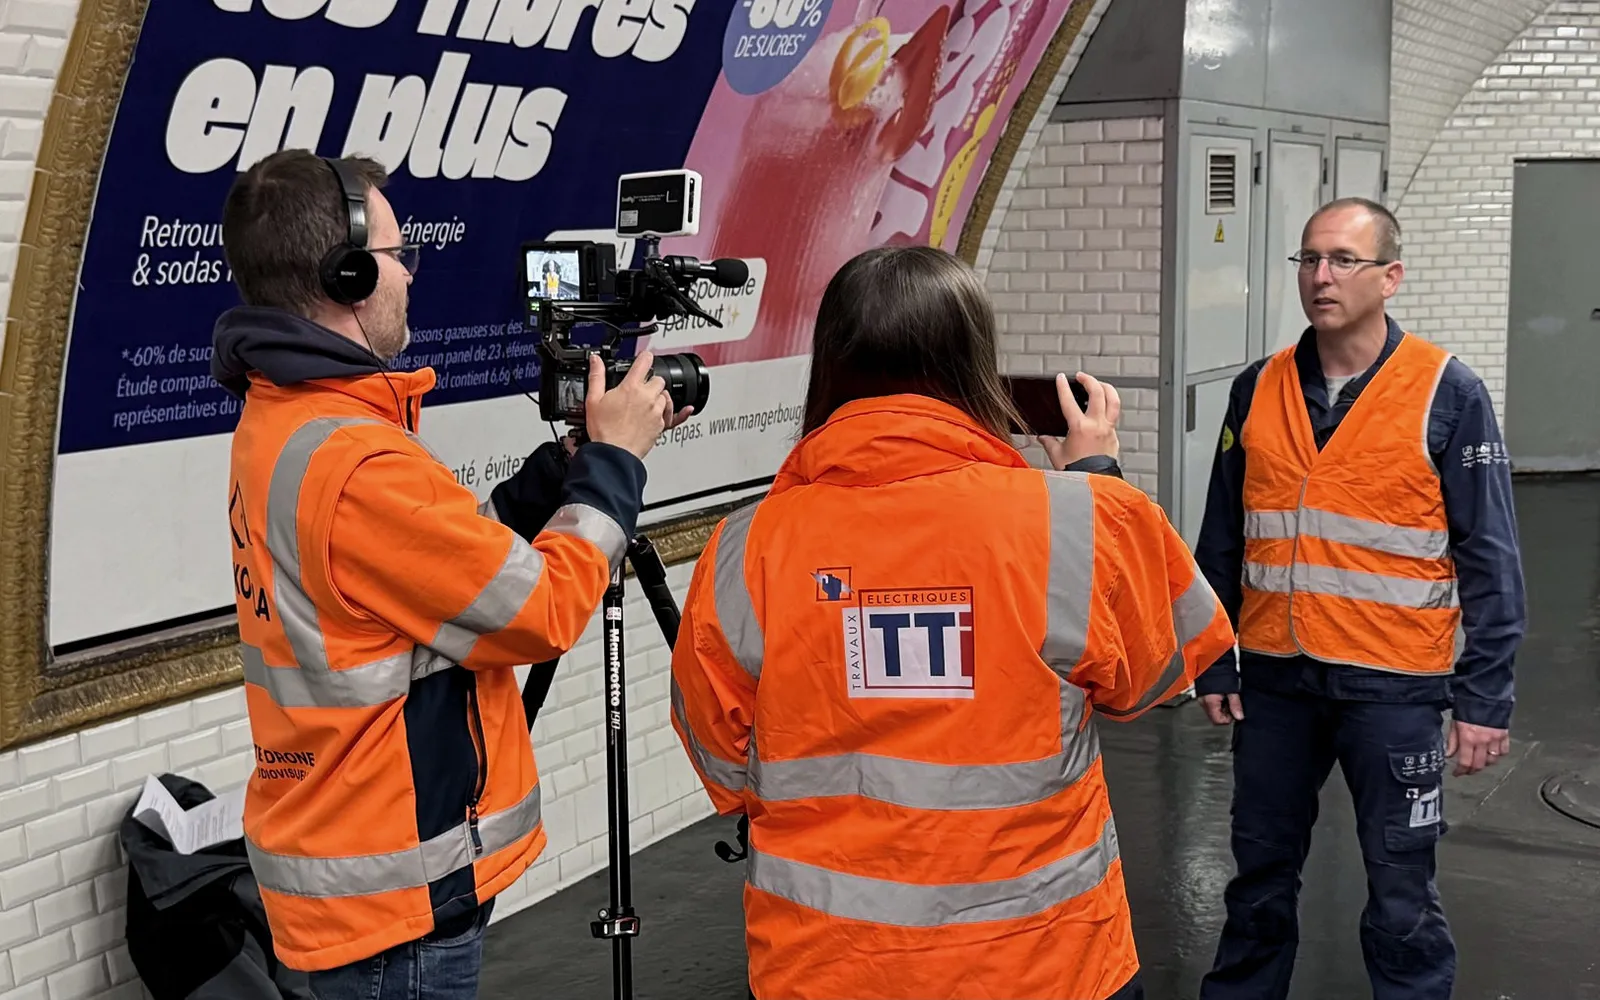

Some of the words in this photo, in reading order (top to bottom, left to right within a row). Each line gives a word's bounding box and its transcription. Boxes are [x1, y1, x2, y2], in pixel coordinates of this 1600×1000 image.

[417, 0, 697, 62] res
[734, 34, 757, 58] DE
[166, 57, 335, 173] en
[341, 51, 568, 181] plus
[401, 214, 466, 251] énergie
[132, 252, 151, 286] &
[154, 250, 223, 285] sodas
[443, 325, 489, 345] gazeuses
[488, 319, 524, 337] sucées
[168, 343, 187, 364] de
[412, 353, 430, 368] sur
[430, 352, 445, 367] un
[444, 345, 474, 370] panel
[473, 344, 488, 362] de
[487, 343, 503, 361] 23
[116, 373, 158, 398] Étude
[160, 374, 223, 396] compara
[449, 369, 490, 389] contient
[113, 400, 217, 432] représentatives
[219, 394, 238, 416] du
[670, 422, 704, 449] repas.
[867, 591, 968, 605] ELECTRIQUES
[847, 614, 862, 691] TRAVAUX
[608, 628, 621, 707] Manfrotto
[609, 710, 621, 730] 190
[263, 749, 316, 768] DRONE
